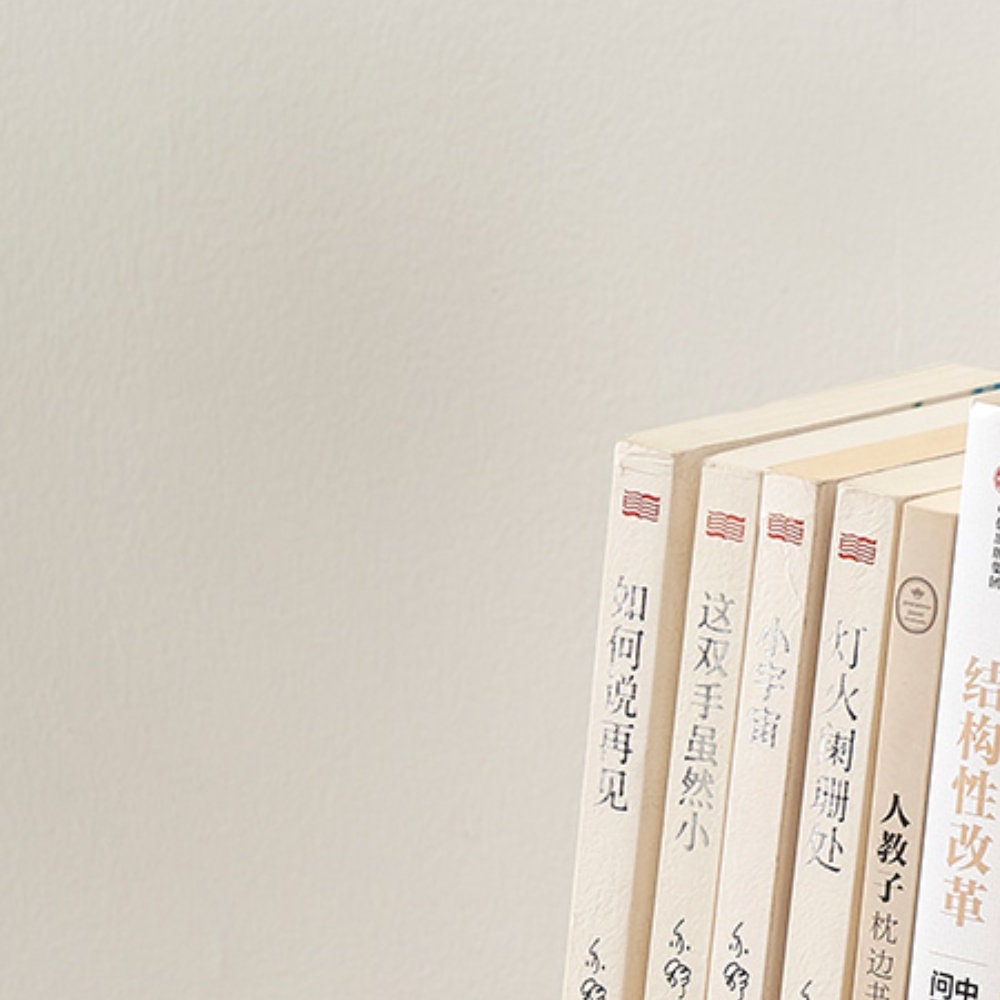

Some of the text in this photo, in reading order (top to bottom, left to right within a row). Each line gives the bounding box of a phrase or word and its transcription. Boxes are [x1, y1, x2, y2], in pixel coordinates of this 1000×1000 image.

[599, 575, 649, 812] 如何说再见
[676, 590, 736, 853] 这双手虽然小
[806, 619, 866, 873] 灯火阑珊处
